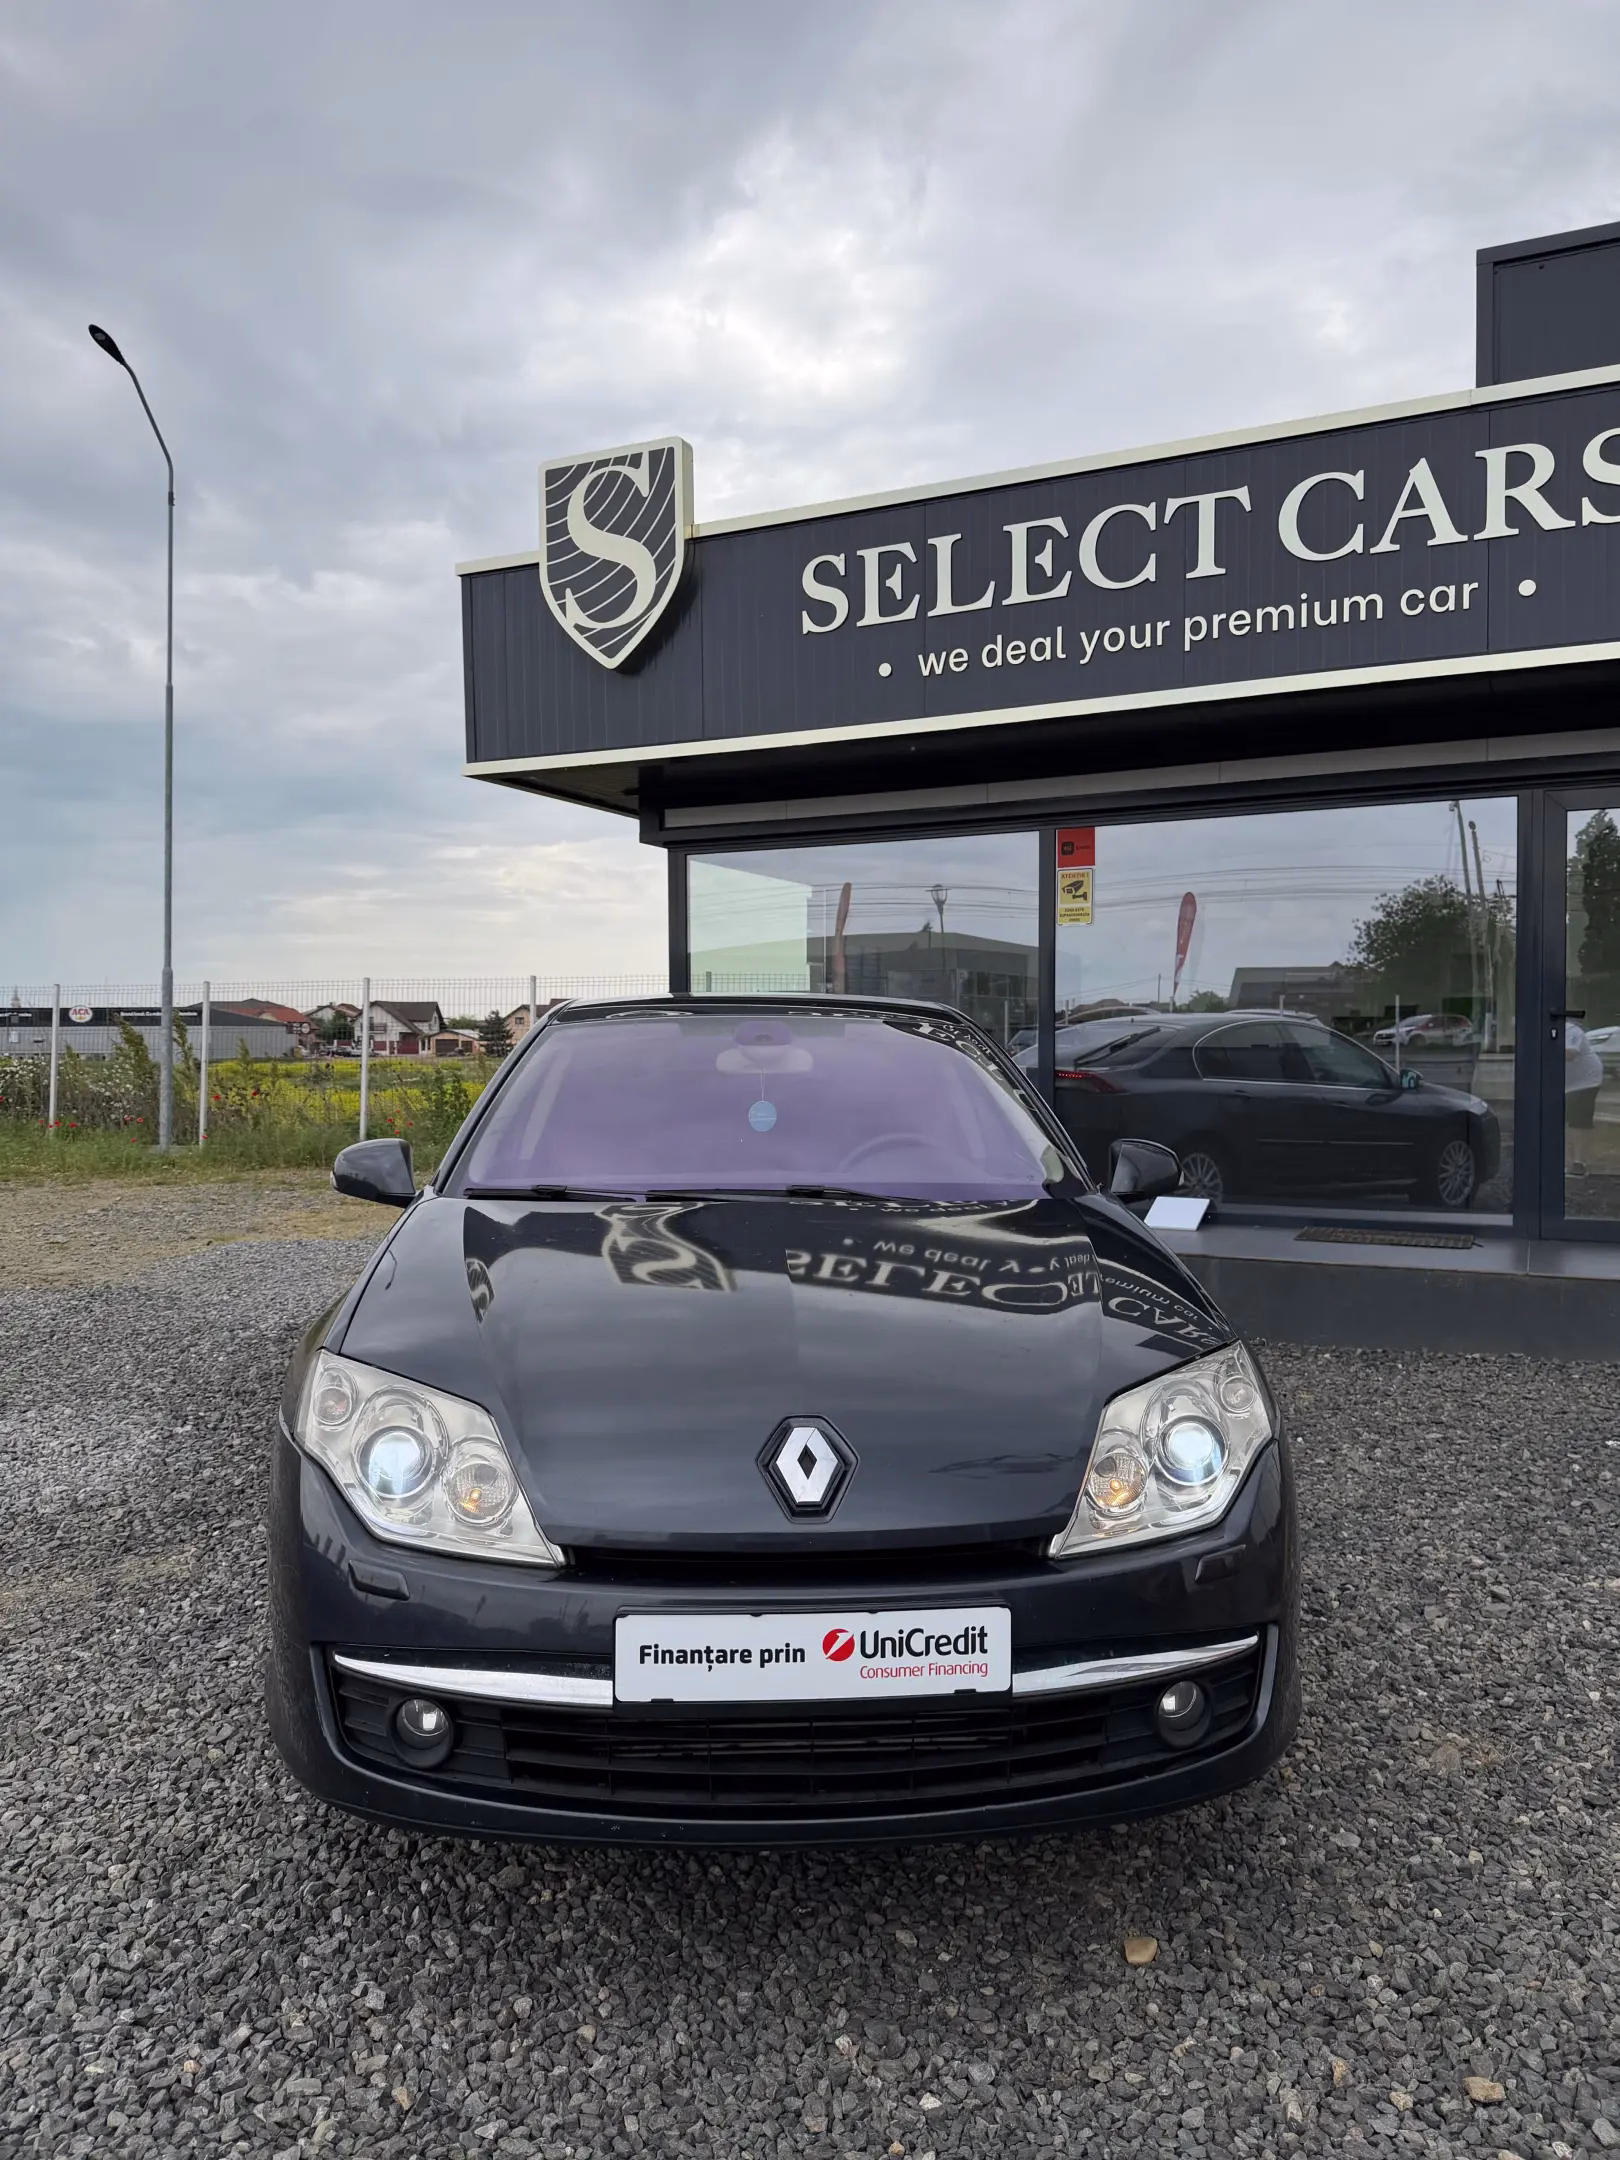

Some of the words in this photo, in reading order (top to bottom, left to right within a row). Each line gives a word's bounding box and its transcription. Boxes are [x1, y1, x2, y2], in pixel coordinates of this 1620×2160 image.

[801, 485, 1252, 635] SELECT
[1278, 427, 1620, 561] CARS
[917, 648, 969, 677] we
[981, 625, 1067, 668] deal
[1079, 620, 1171, 665] your
[1184, 593, 1383, 652] premium
[1400, 582, 1479, 616] car
[71, 1008, 91, 1016] ACA
[759, 1642, 806, 1669] prin
[860, 1625, 988, 1660] UniCredit
[859, 1663, 925, 1679] Consumer
[928, 1660, 989, 1677] Financing
